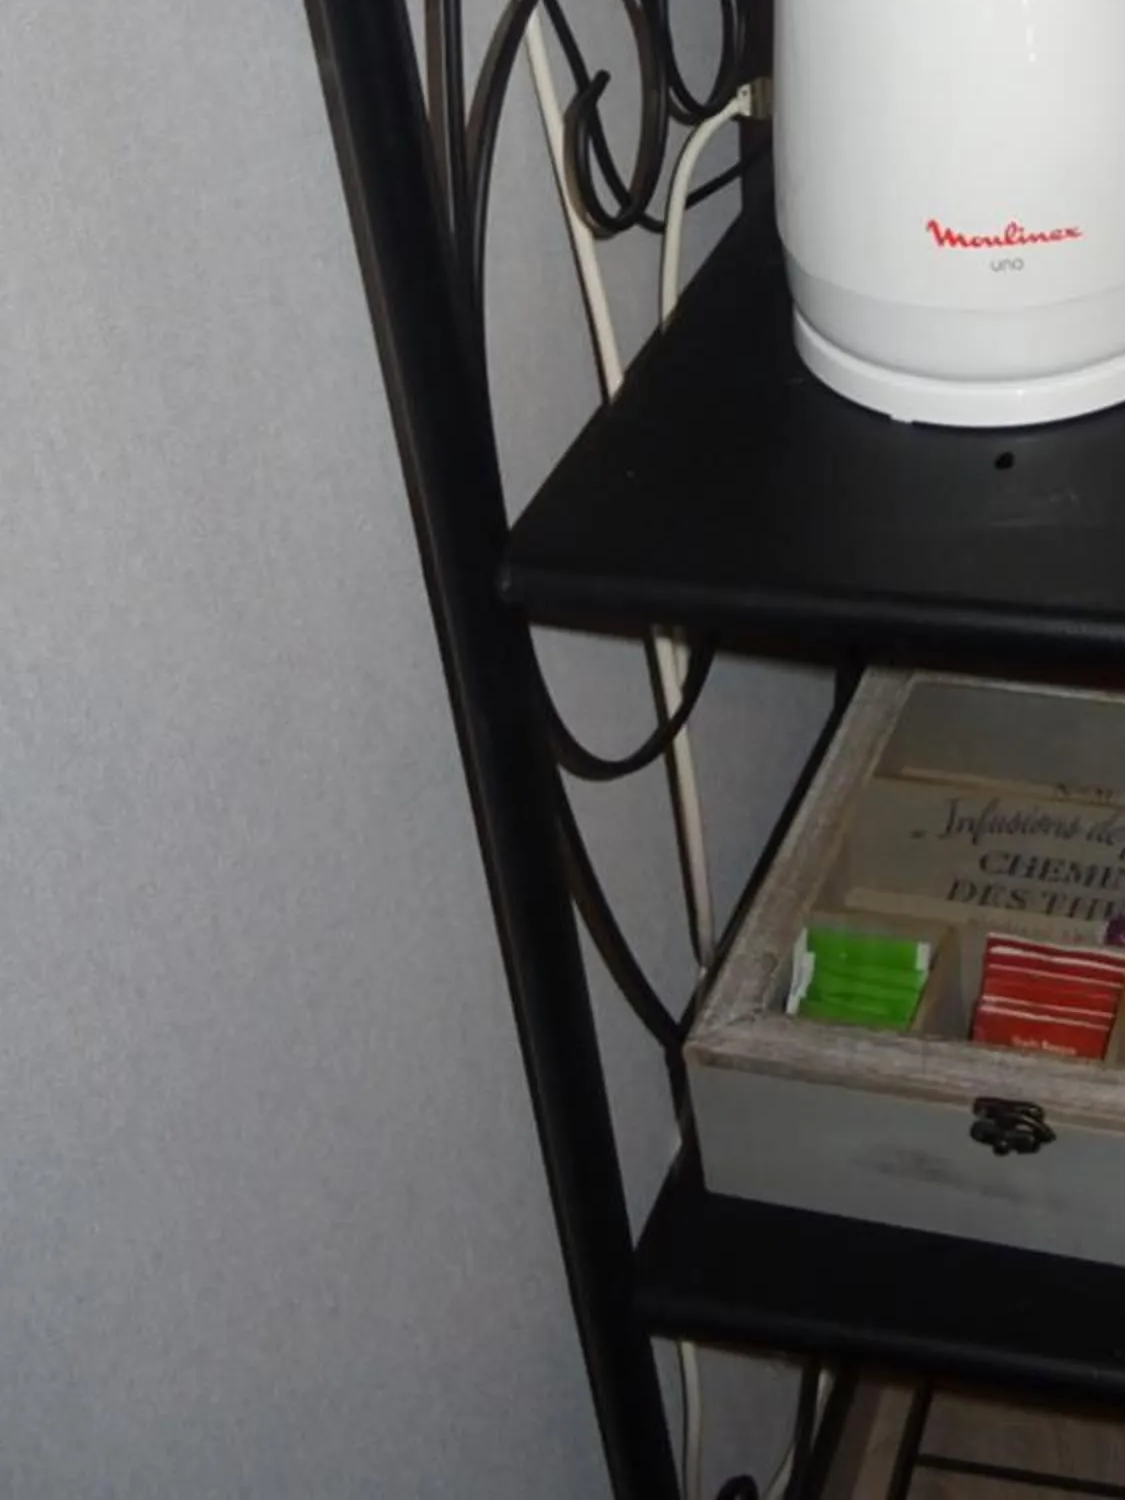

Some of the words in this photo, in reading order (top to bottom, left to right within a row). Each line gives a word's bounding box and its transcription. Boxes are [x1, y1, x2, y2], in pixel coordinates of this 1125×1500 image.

[926, 217, 1084, 248] Moulinex
[989, 257, 1025, 272] uno
[936, 797, 1082, 847] Infusions
[945, 874, 1032, 911] DES
